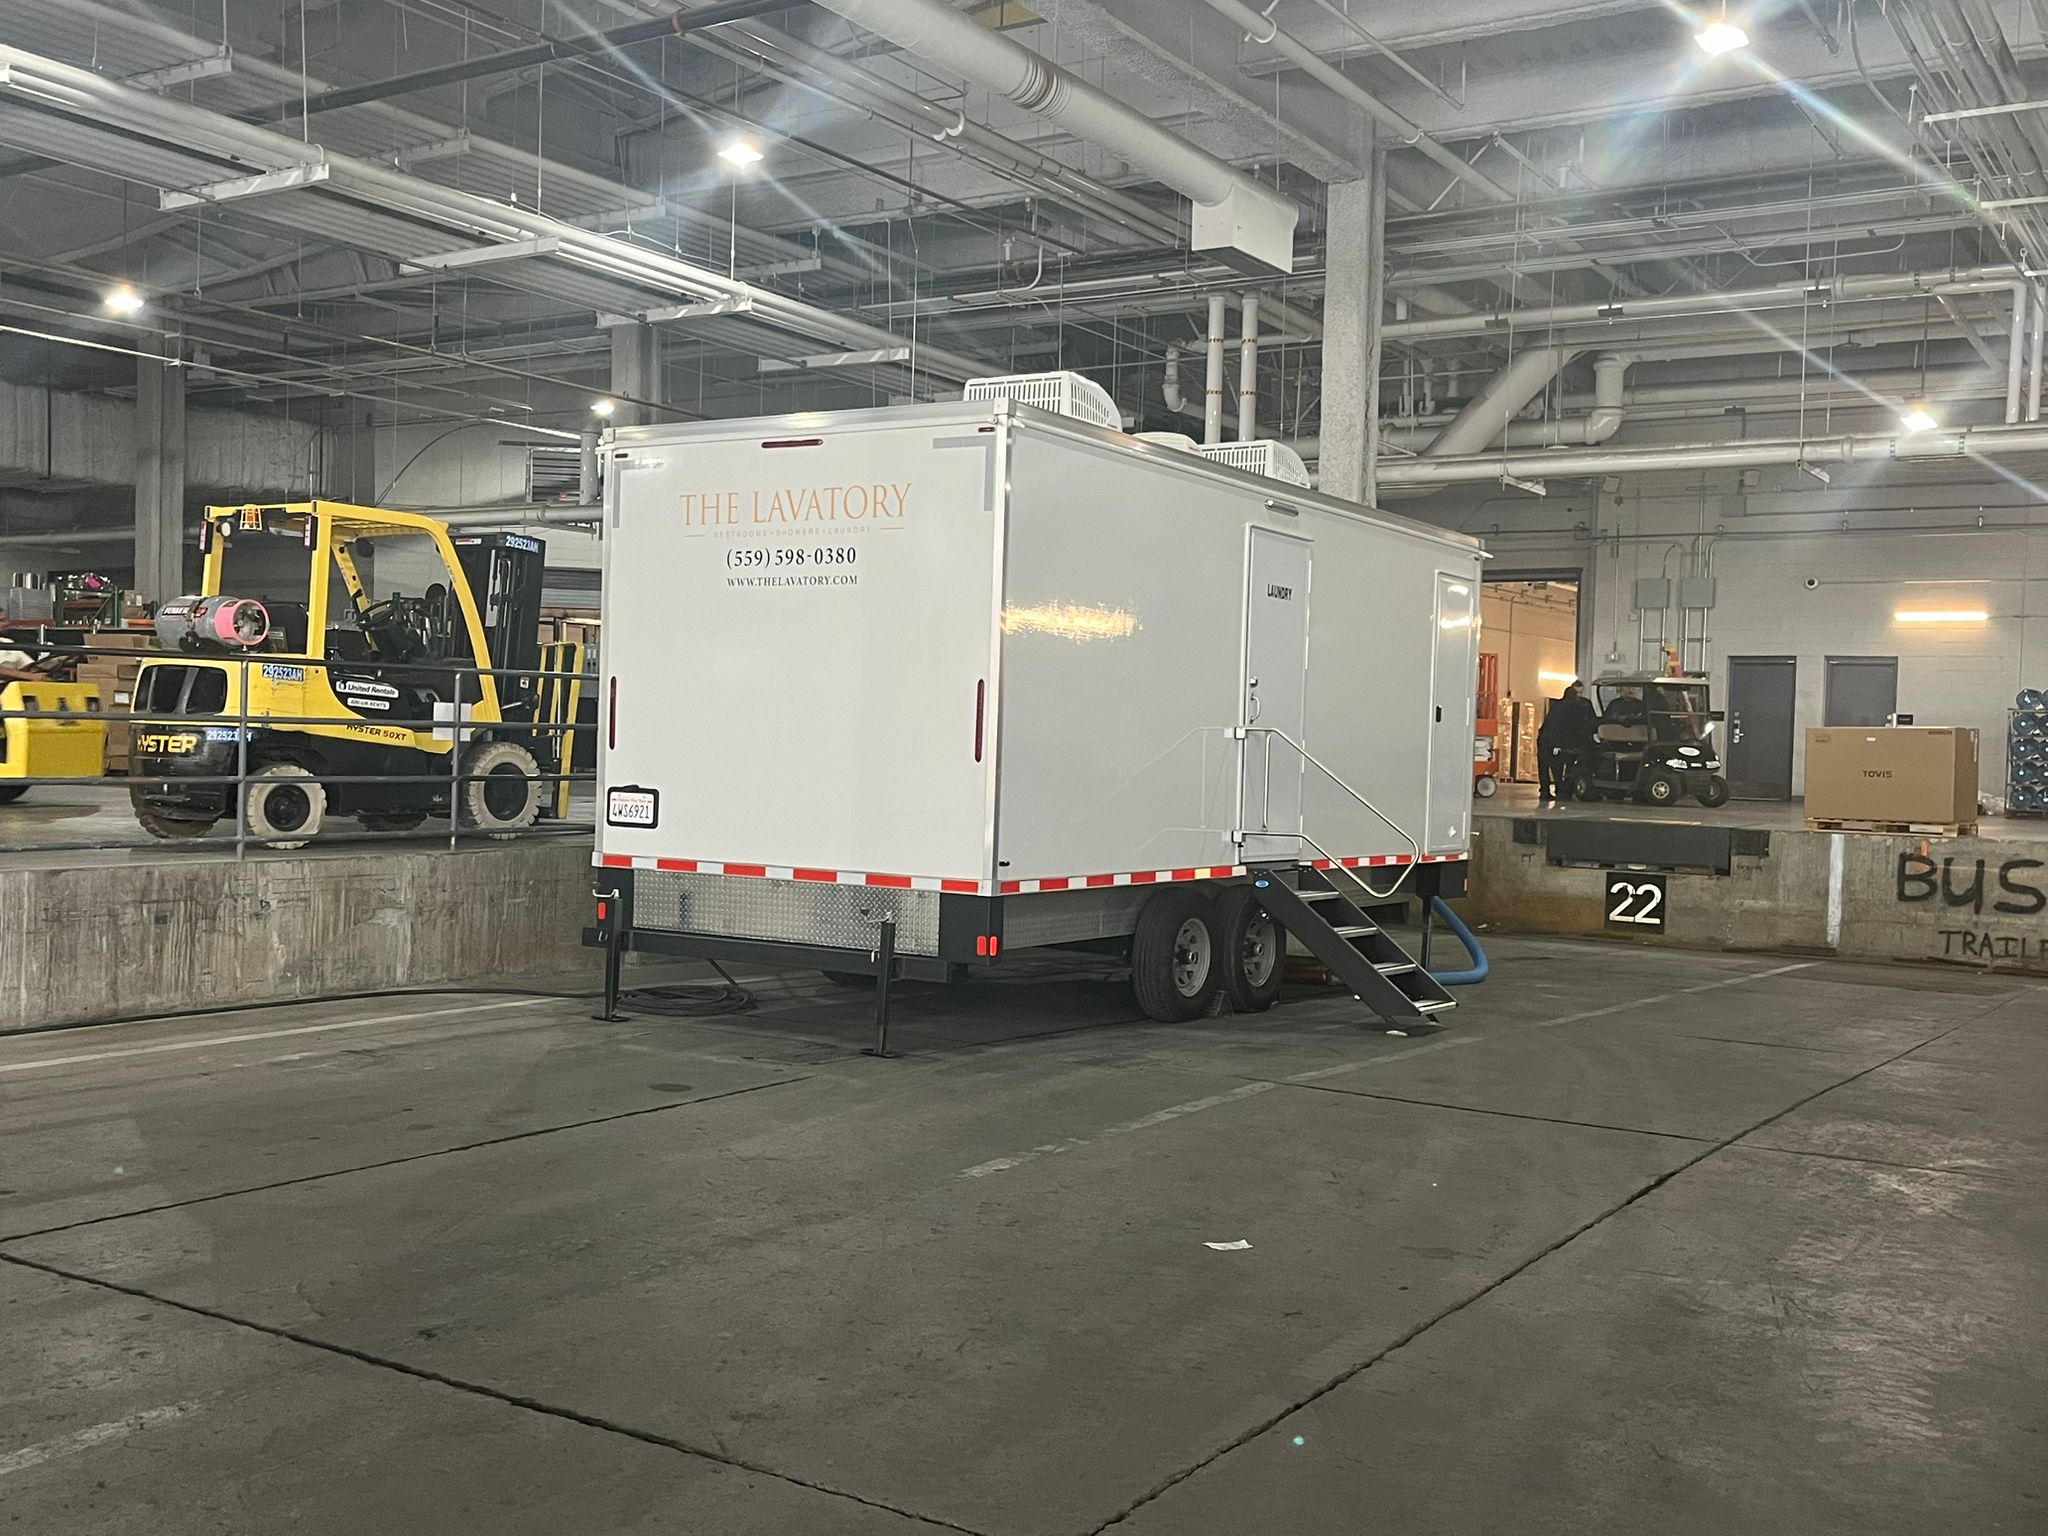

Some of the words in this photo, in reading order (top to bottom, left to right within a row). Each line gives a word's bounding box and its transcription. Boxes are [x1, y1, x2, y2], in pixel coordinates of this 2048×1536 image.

[680, 493, 739, 525] THE
[753, 483, 912, 523] LAVATORY
[713, 531, 767, 539] RESTROOMS
[775, 529, 820, 537] SHOWERS
[828, 526, 871, 535] LAUNDRY
[726, 547, 770, 570] (559)
[774, 546, 857, 566] 598-0380
[727, 574, 858, 587] WWW.THELAVATORY.COM
[1267, 583, 1292, 600] LAUNDRY
[263, 665, 303, 682] 292523AH
[348, 683, 370, 693] United
[371, 686, 395, 696] Rentals
[383, 730, 406, 741] 50XT
[1897, 852, 2047, 915] BUS
[1609, 881, 1662, 925] 22
